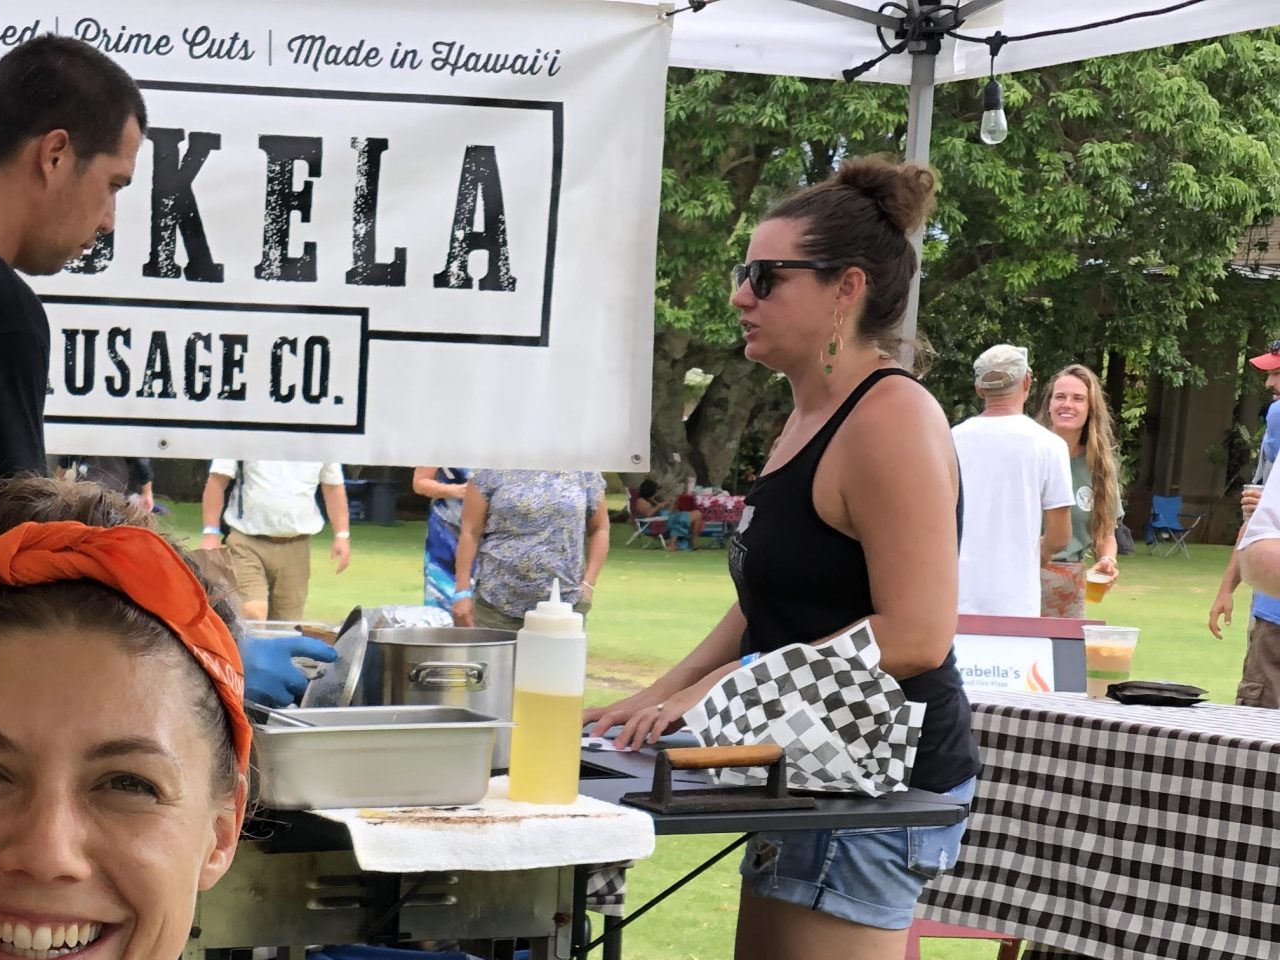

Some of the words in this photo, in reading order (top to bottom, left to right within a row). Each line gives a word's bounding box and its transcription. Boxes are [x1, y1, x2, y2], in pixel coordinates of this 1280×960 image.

[74, 17, 174, 56] Prime
[182, 25, 256, 62] Cuts
[287, 34, 383, 72] Made
[390, 41, 423, 70] in
[270, 335, 344, 405] CO.
